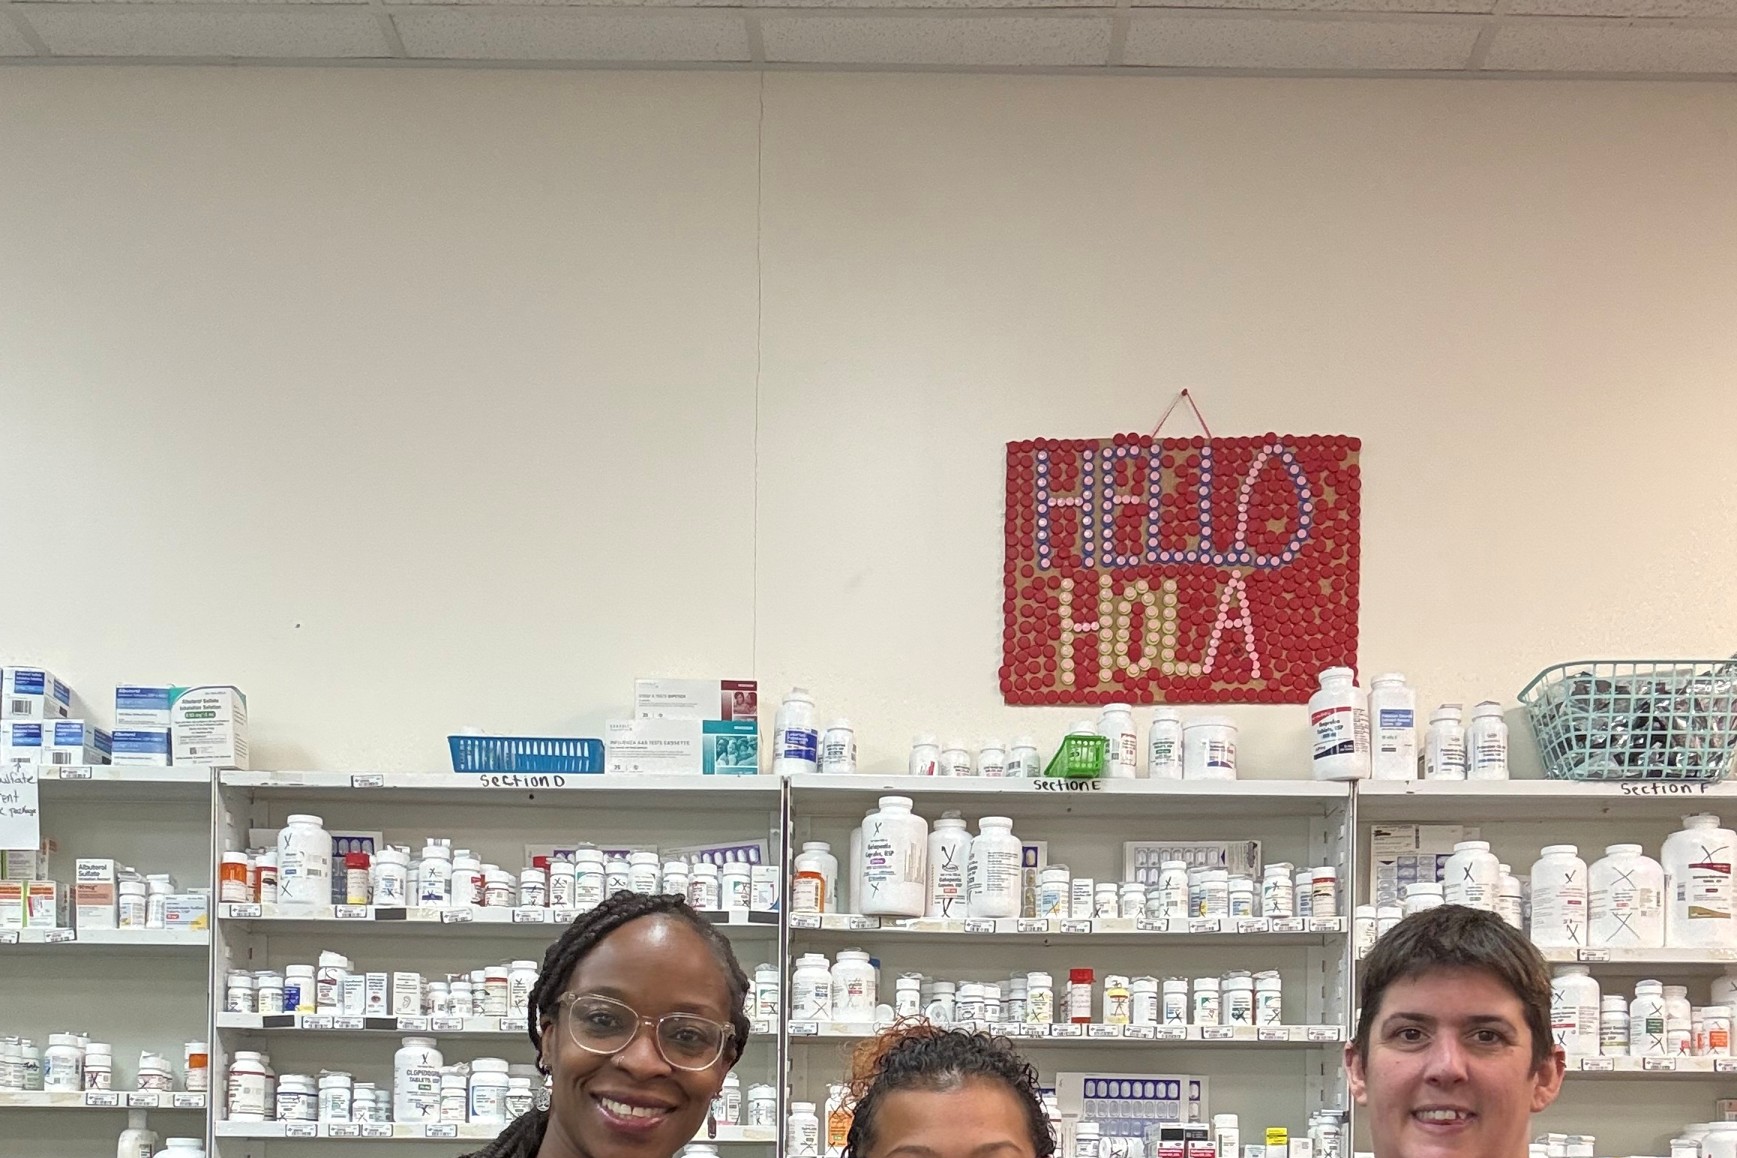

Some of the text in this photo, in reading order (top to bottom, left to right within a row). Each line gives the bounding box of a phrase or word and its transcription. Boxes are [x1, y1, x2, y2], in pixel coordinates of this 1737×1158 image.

[1036, 444, 1312, 568] HELLO
[1058, 570, 1262, 685] HOLA
[480, 774, 565, 787] Section D
[1033, 779, 1101, 791] Section E
[1621, 782, 1712, 795] Section F
